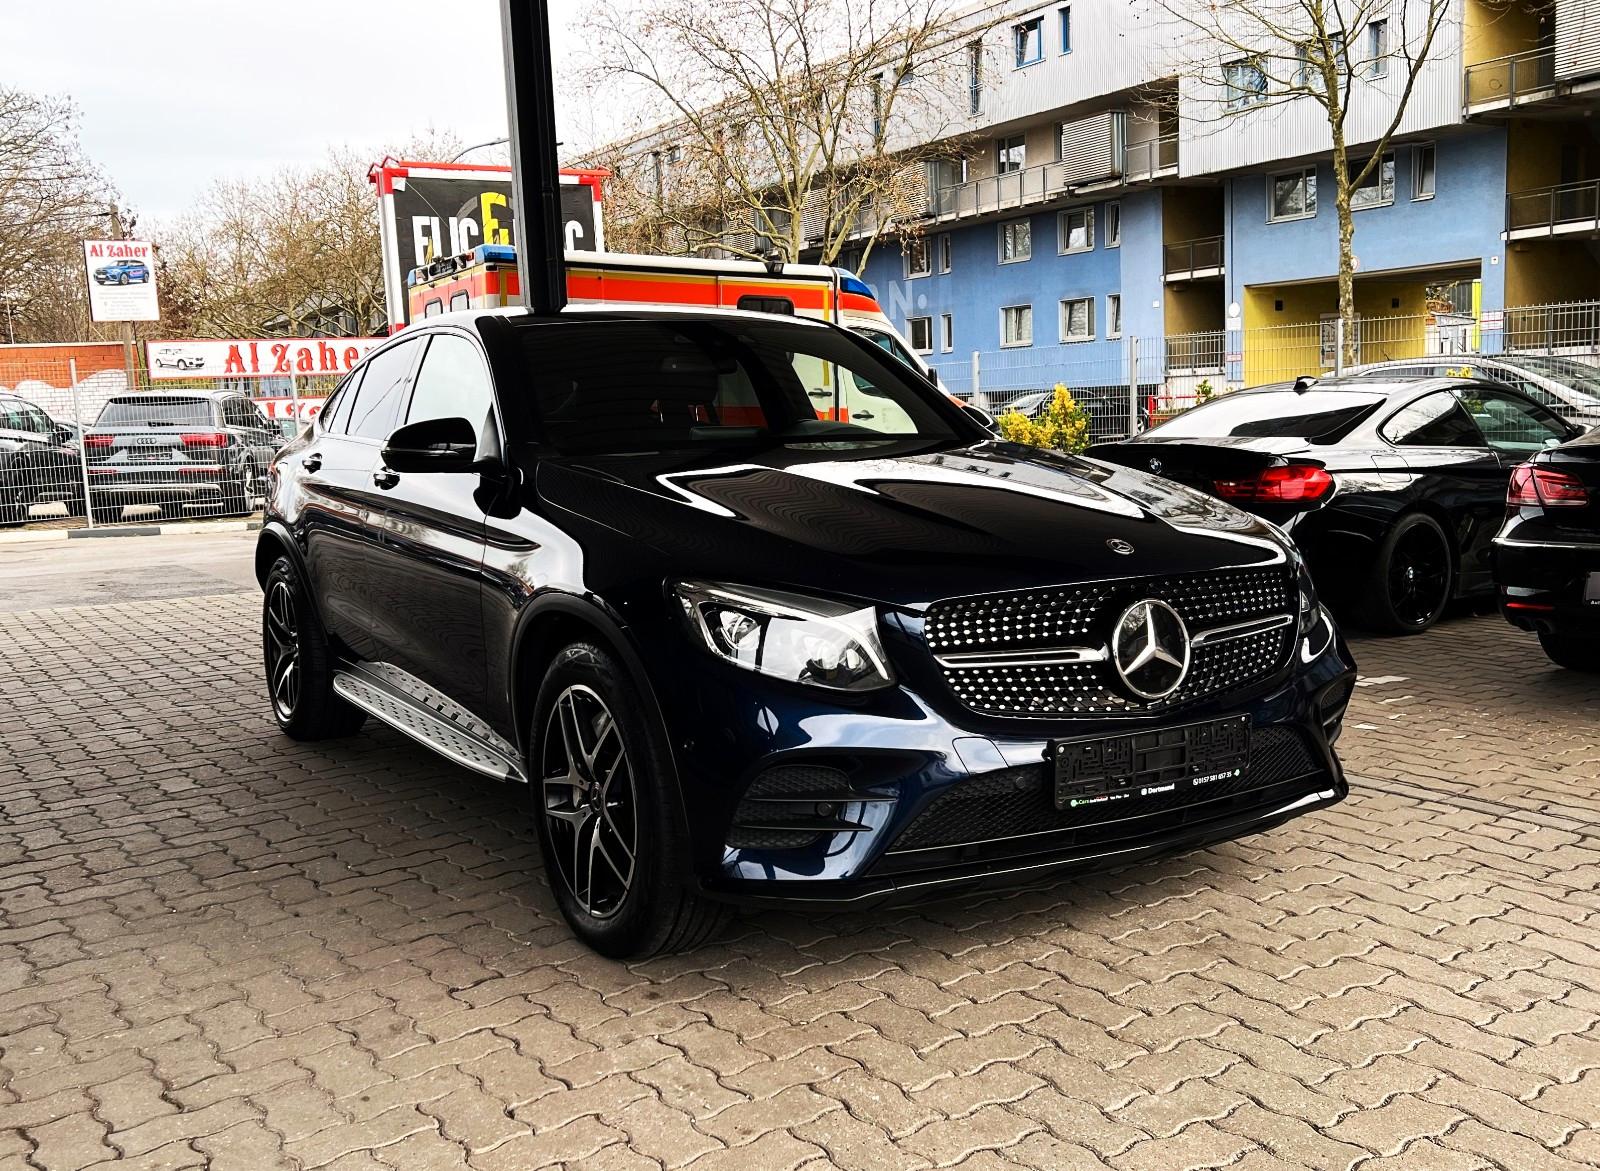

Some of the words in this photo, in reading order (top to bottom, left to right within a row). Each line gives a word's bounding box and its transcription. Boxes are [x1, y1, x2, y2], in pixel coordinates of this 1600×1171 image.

[90, 244, 104, 257] Al
[106, 244, 148, 258] Zaher
[224, 342, 260, 374] Al
[270, 341, 375, 373] Zahe
[1147, 782, 1175, 794] Dortmund
